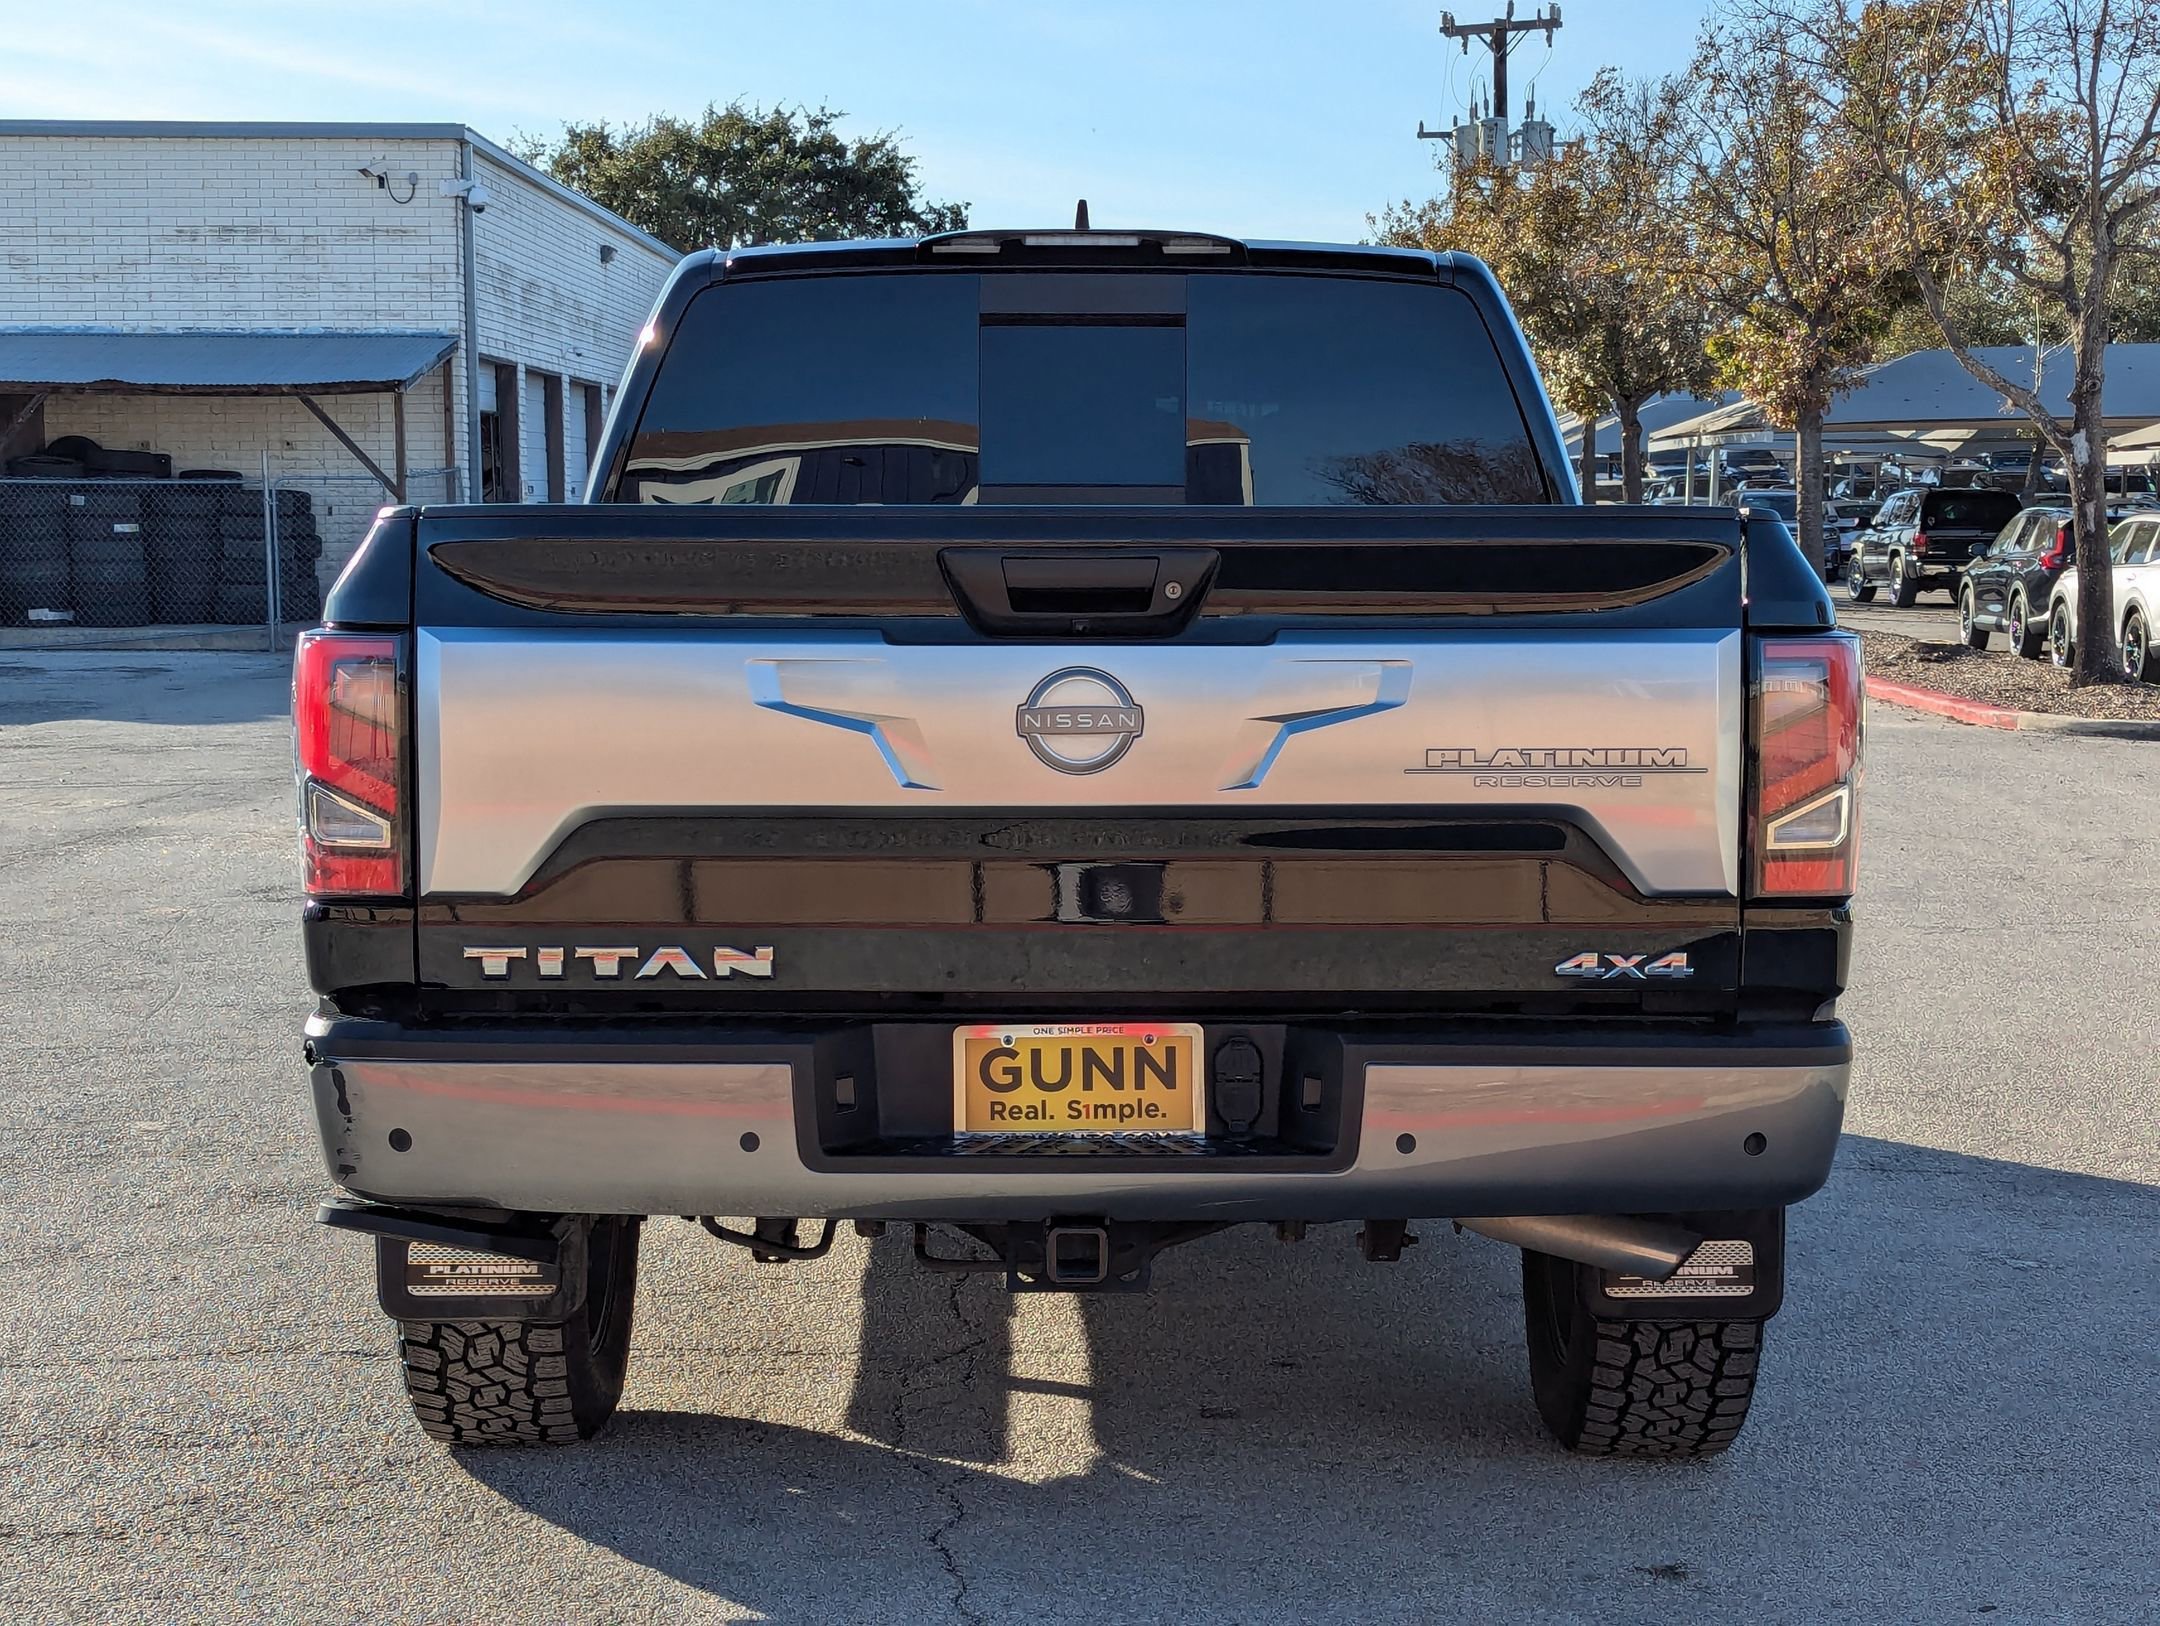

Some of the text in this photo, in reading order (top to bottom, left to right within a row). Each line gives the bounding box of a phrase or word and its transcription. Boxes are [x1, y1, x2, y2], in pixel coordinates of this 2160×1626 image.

[1024, 713, 1135, 728] NISSAN
[1425, 748, 1687, 768] PLATINUM
[1474, 775, 1642, 788] RESERVE
[463, 945, 775, 980] TITAN
[1033, 1026, 1124, 1035] ONE SIMPLE PRICE
[979, 1045, 1177, 1093] GUNN
[990, 1099, 1055, 1121] Real.
[429, 1265, 538, 1275] PLATINUM
[445, 1278, 520, 1286] RESERVE
